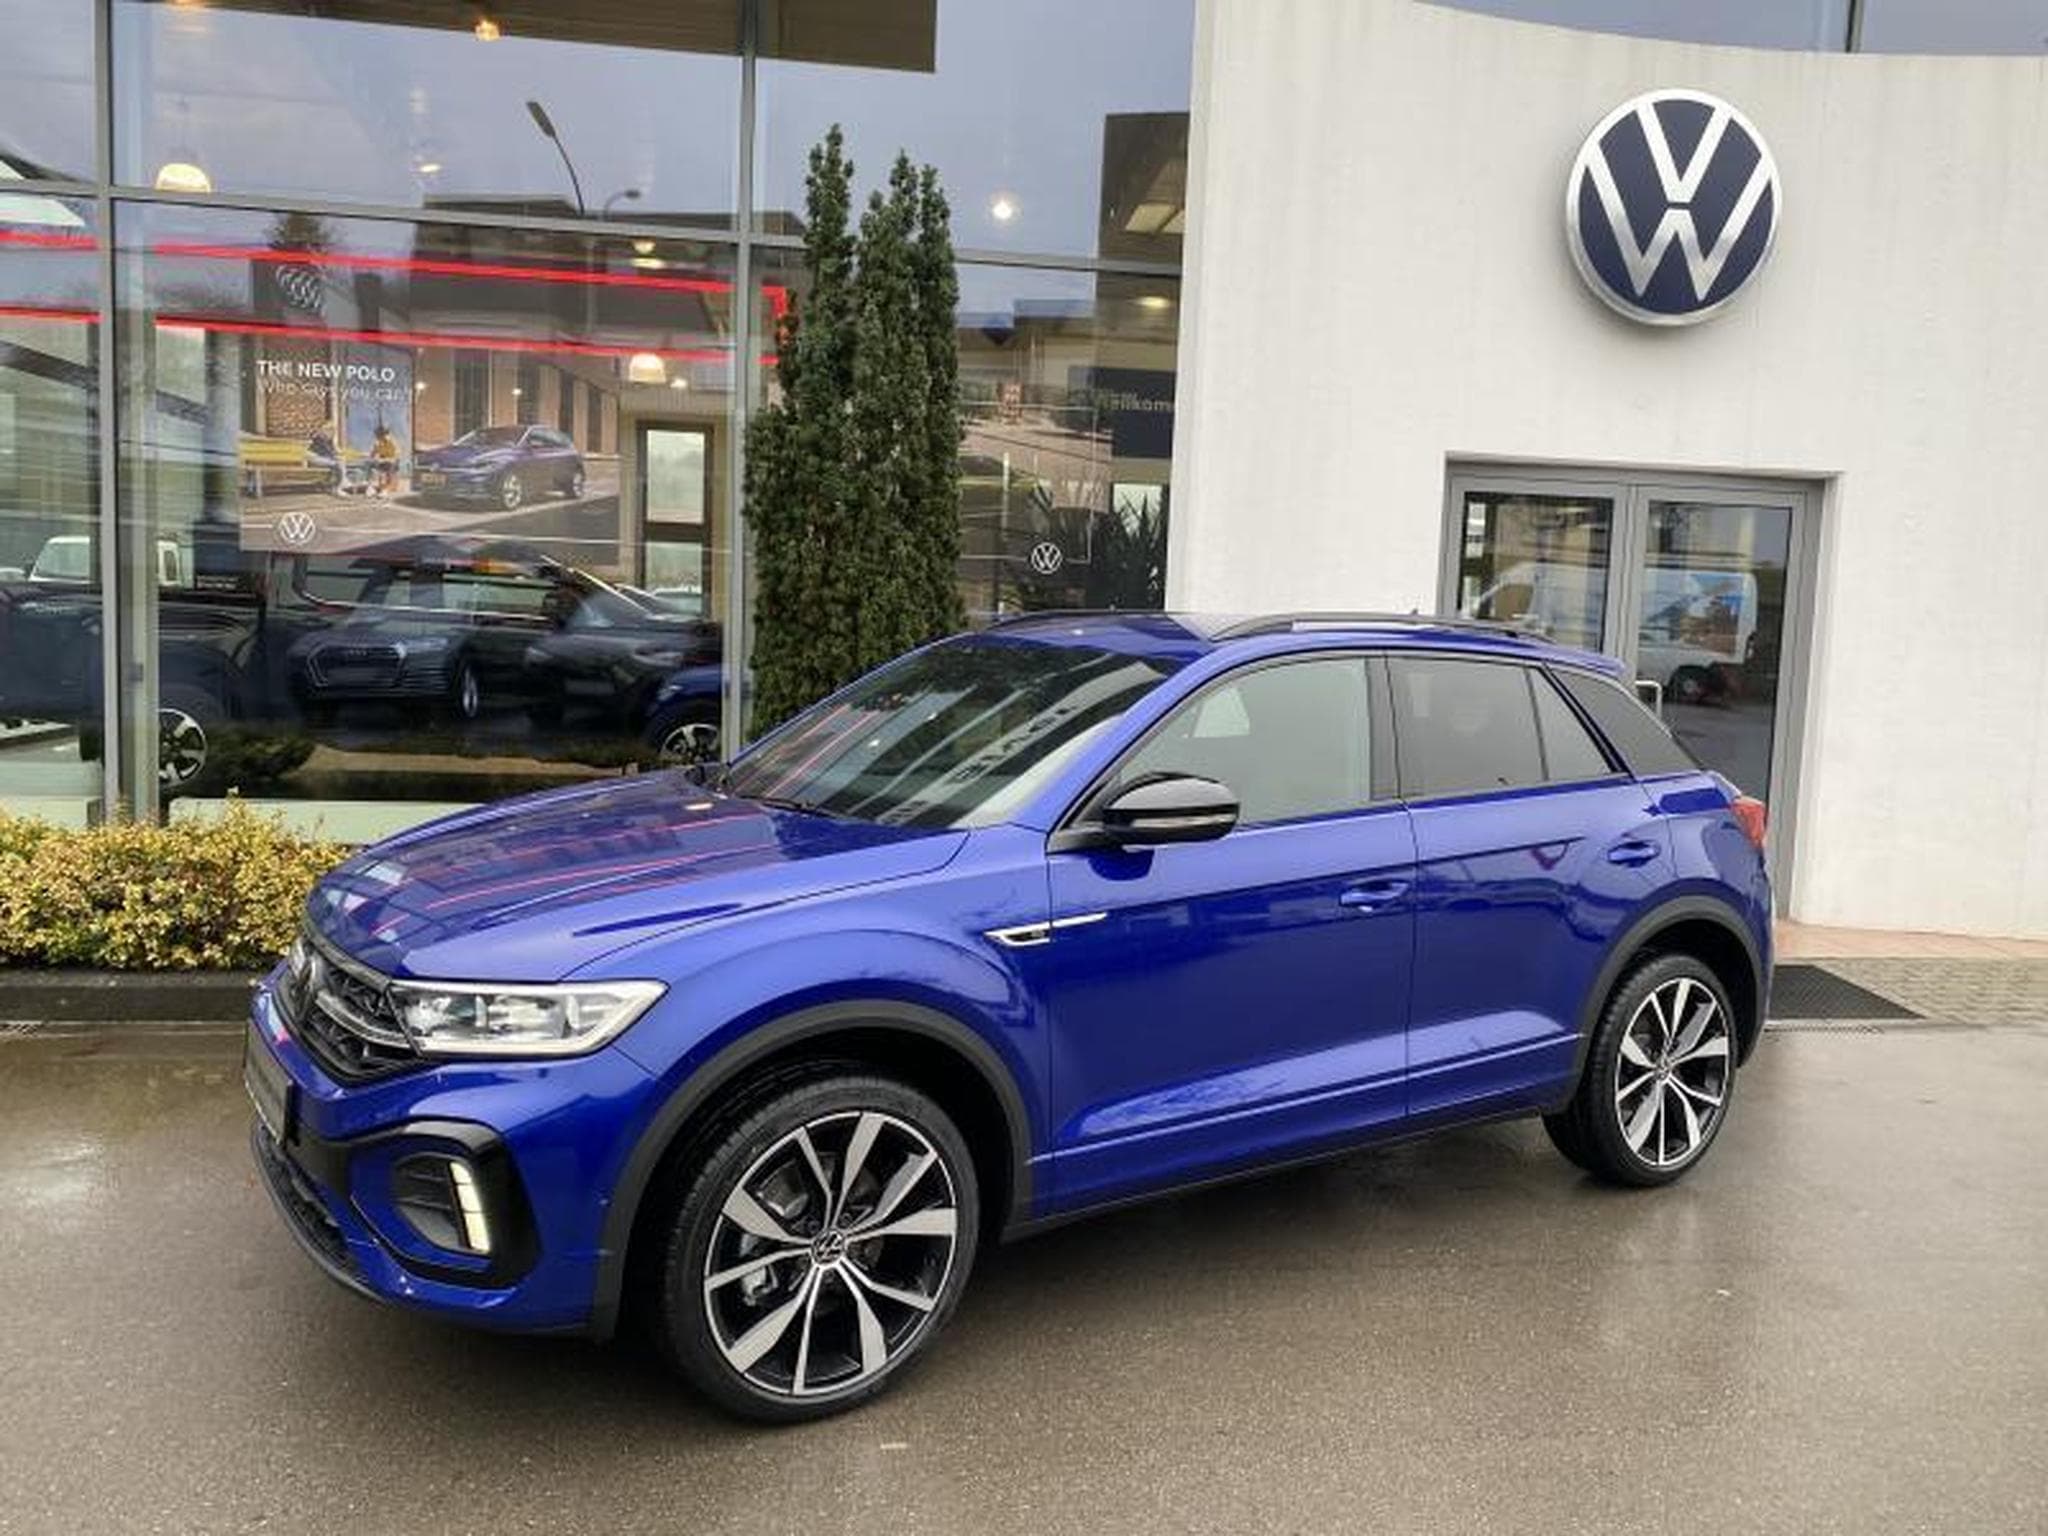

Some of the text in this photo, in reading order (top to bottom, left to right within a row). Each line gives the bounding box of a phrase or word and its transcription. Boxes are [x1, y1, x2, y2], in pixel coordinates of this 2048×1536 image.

[256, 360, 396, 383] THE NEW POLO
[301, 382, 338, 400] say
[1095, 389, 1173, 411] Willkom
